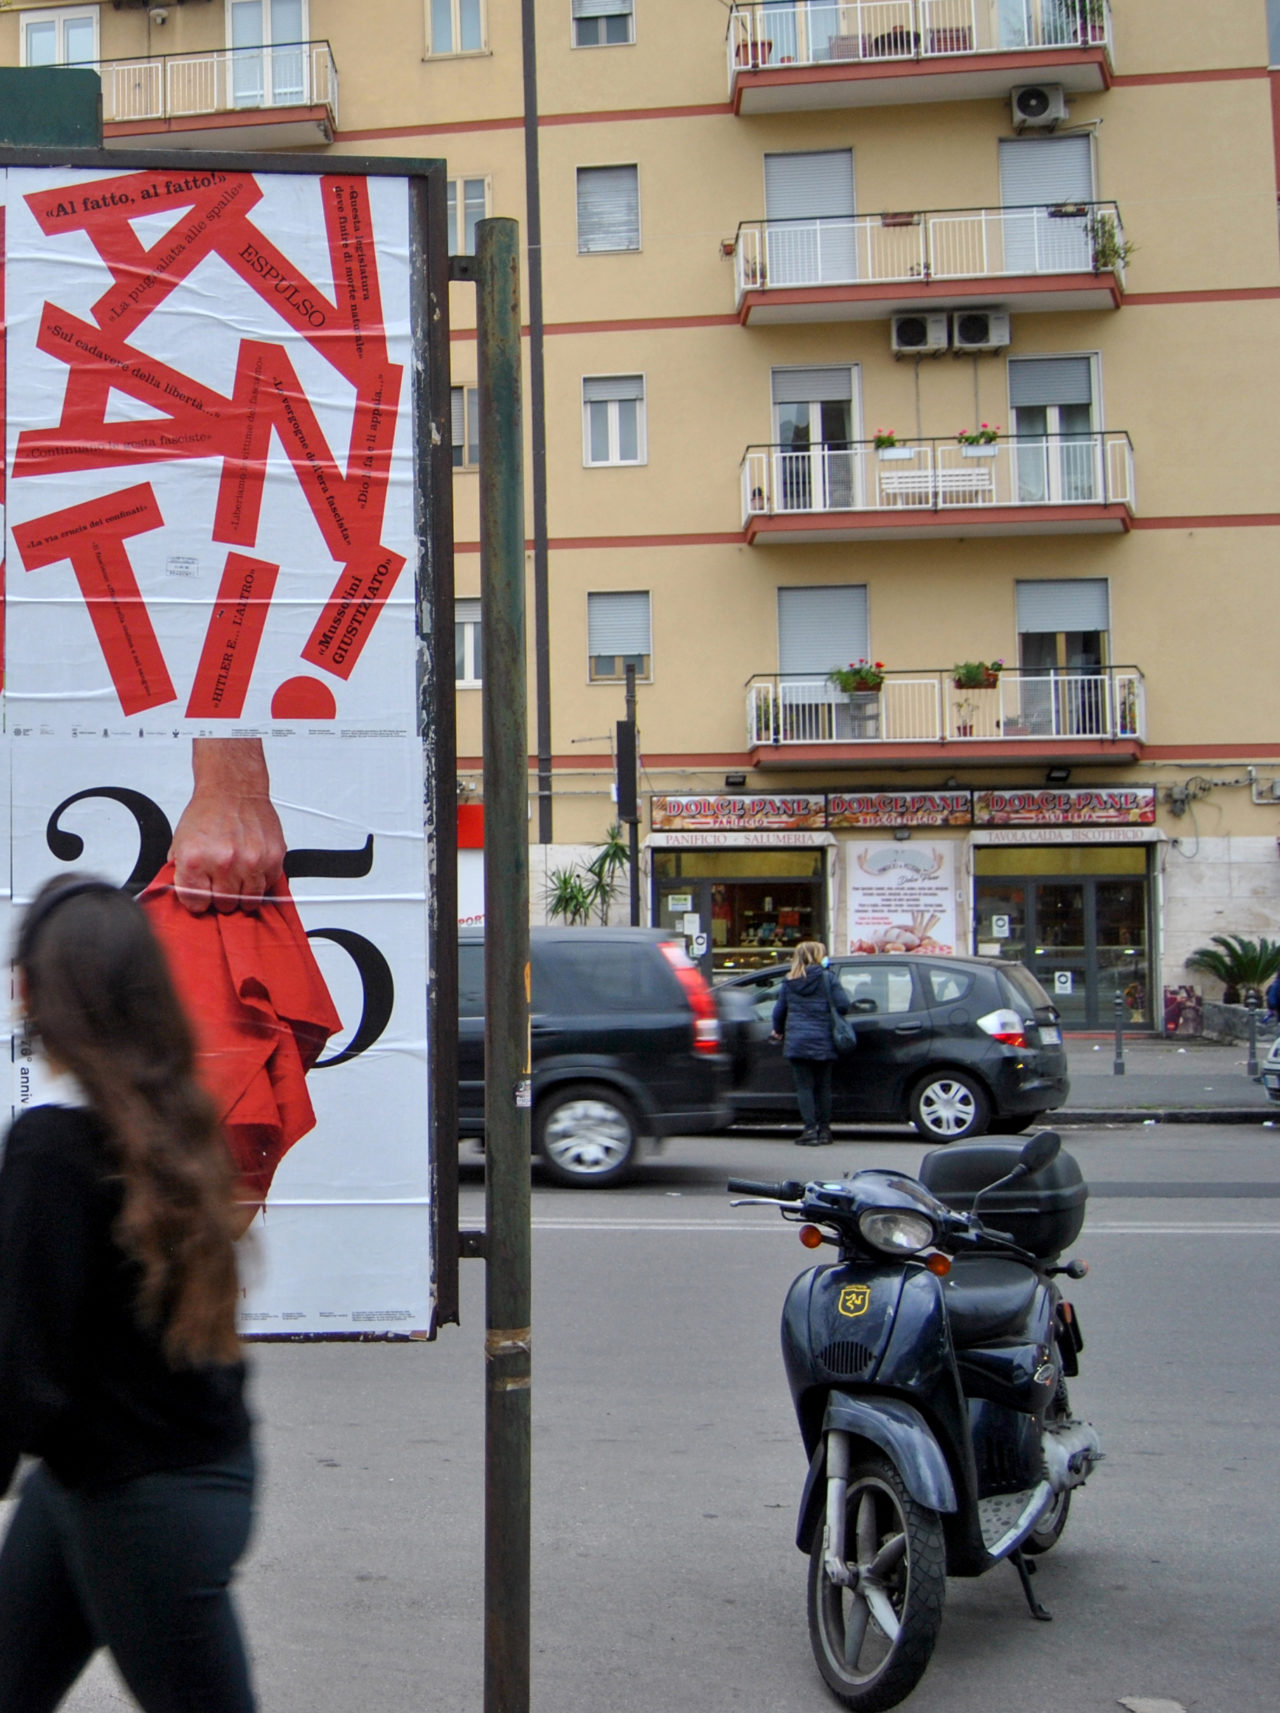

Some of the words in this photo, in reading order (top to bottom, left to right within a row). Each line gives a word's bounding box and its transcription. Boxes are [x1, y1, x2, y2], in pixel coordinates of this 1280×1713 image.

[83, 188, 135, 211] fatto,
[141, 183, 160, 199] al
[335, 185, 345, 213] deve
[185, 220, 207, 247] alle
[338, 216, 349, 249] finire
[344, 251, 353, 264] di
[238, 242, 326, 328] ESPULSO
[345, 266, 357, 300] morte
[73, 335, 130, 374] cadavere
[131, 364, 162, 391] della
[281, 397, 310, 450] vergogne
[242, 425, 253, 462] vittime
[44, 533, 59, 544] via
[60, 523, 89, 538] crucis
[667, 799, 744, 817] DOLCE
[750, 799, 810, 816] PANE
[831, 797, 907, 814] DOLCE
[910, 795, 969, 813] PANE
[989, 792, 1070, 811] DOLCE
[1076, 792, 1138, 810] PANE
[712, 818, 765, 827] PANIFICIO
[988, 831, 1028, 843] TAVOLA
[1029, 830, 1064, 842] CALDA
[1072, 829, 1144, 841] BISCOTTIFICIO
[665, 833, 727, 845] PANIFICIO
[744, 833, 815, 845] SALUMERIA
